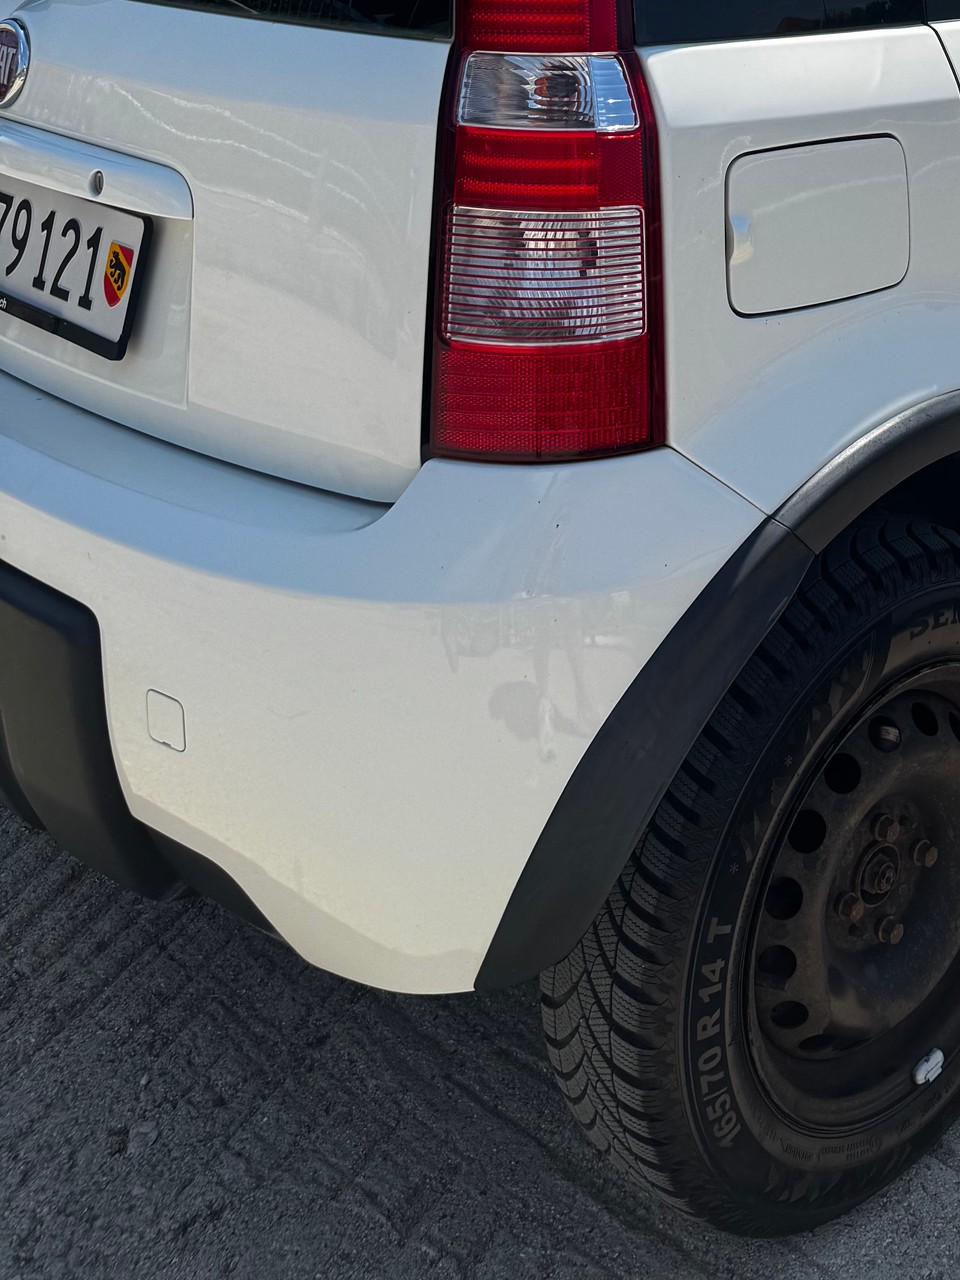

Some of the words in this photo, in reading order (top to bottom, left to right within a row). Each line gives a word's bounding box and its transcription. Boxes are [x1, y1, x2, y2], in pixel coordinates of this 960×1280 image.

[0, 44, 17, 85] AT
[0, 191, 103, 311] 79121
[707, 916, 732, 944] T
